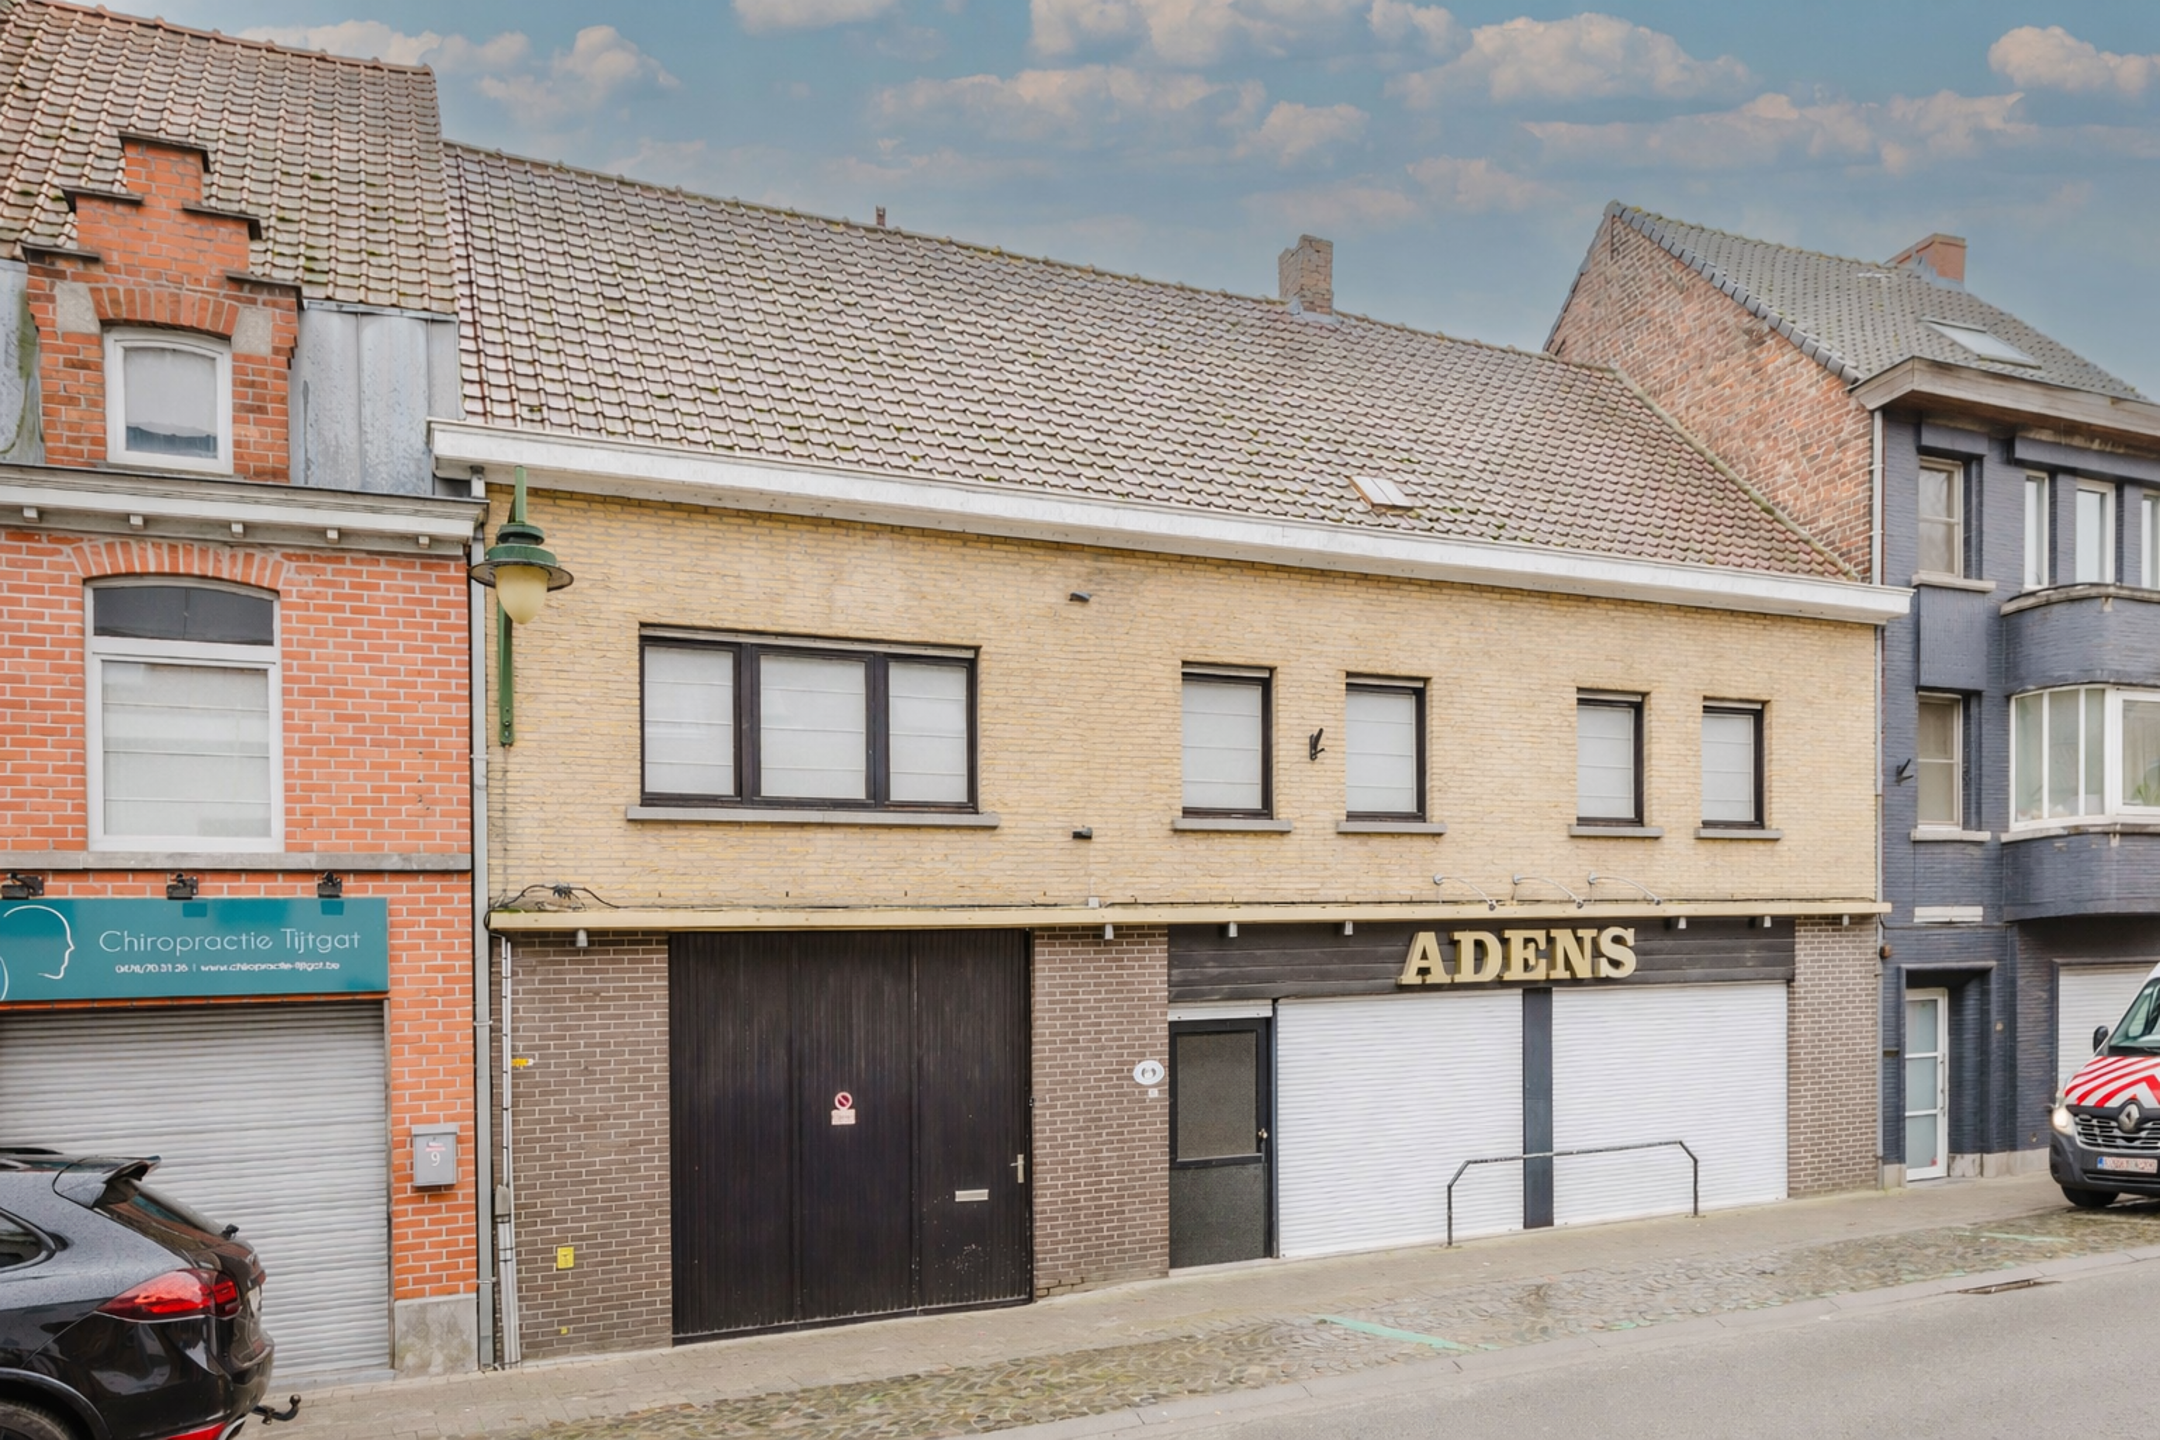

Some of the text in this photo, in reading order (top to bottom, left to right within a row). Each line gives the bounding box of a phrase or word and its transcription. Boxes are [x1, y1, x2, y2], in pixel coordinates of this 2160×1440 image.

[99, 927, 361, 956] Chiropractie Tijtgat
[1397, 926, 1637, 985] ADENS
[431, 1151, 441, 1167] 9
